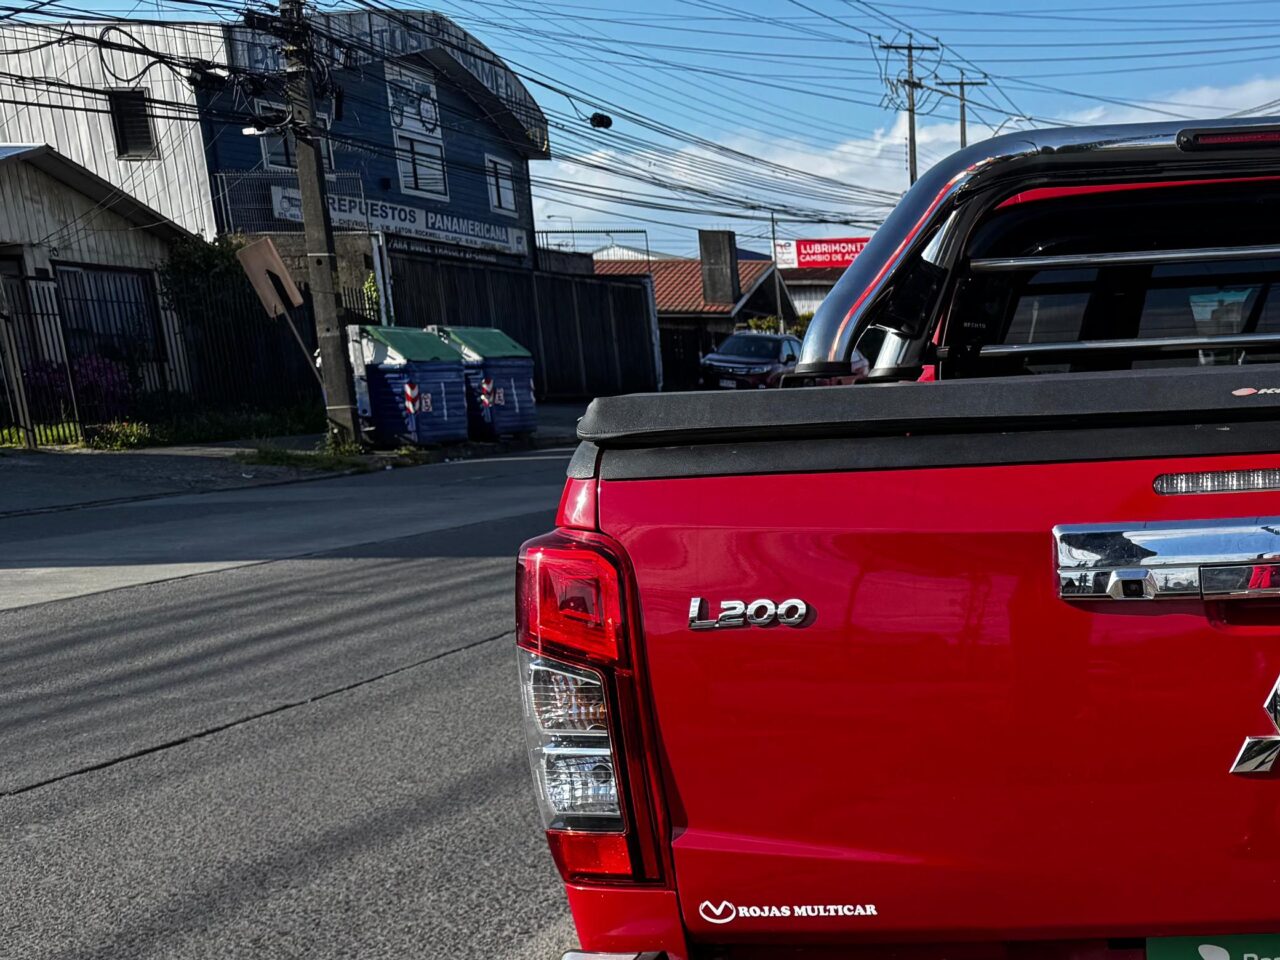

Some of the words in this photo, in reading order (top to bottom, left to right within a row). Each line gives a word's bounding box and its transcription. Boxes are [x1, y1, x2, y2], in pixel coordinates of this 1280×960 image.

[327, 196, 416, 223] REPUESTOS
[427, 212, 508, 241] PANAMERICANA
[801, 242, 867, 254] LUBRIMONT
[800, 254, 830, 262] CAMBIO
[689, 597, 807, 629] L200
[738, 906, 791, 917] ROJAS
[793, 905, 878, 917] MULTICAR
